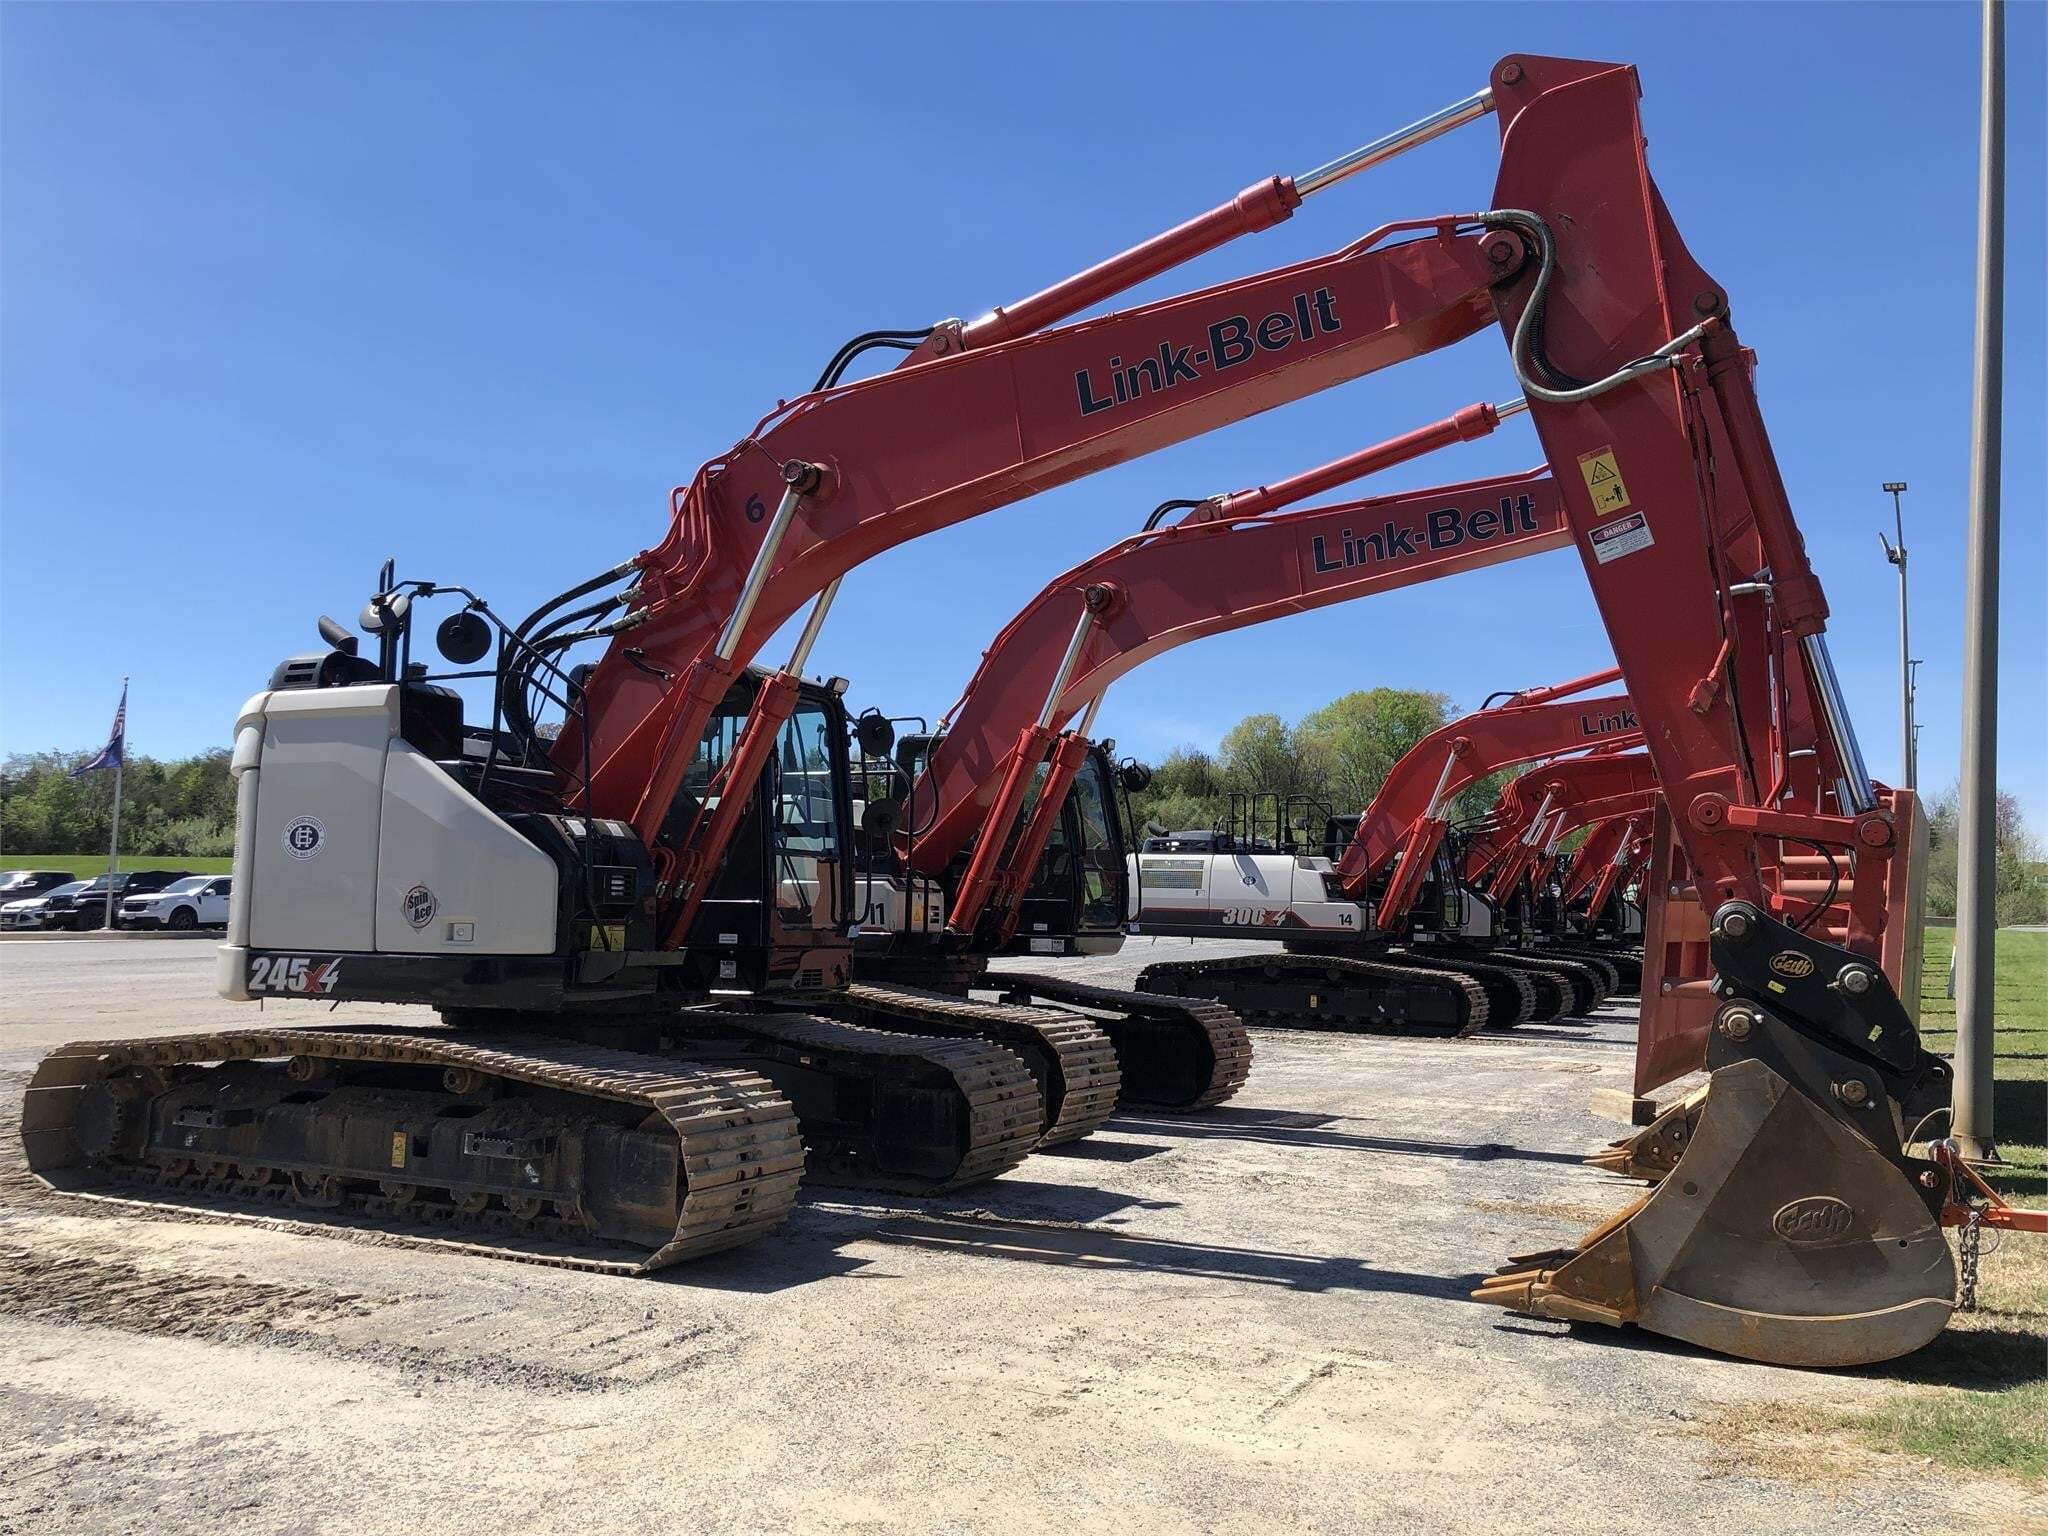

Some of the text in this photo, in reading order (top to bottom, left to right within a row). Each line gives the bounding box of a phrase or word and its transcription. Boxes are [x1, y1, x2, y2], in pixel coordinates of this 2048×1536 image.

[1074, 287, 1342, 417] Link-Belt
[745, 492, 766, 523] 6
[1312, 494, 1539, 574] Link-Belt
[1603, 521, 1633, 538] DANGER
[408, 892, 429, 909] Spin
[414, 905, 432, 921] Ace
[1338, 913, 1354, 926] 14
